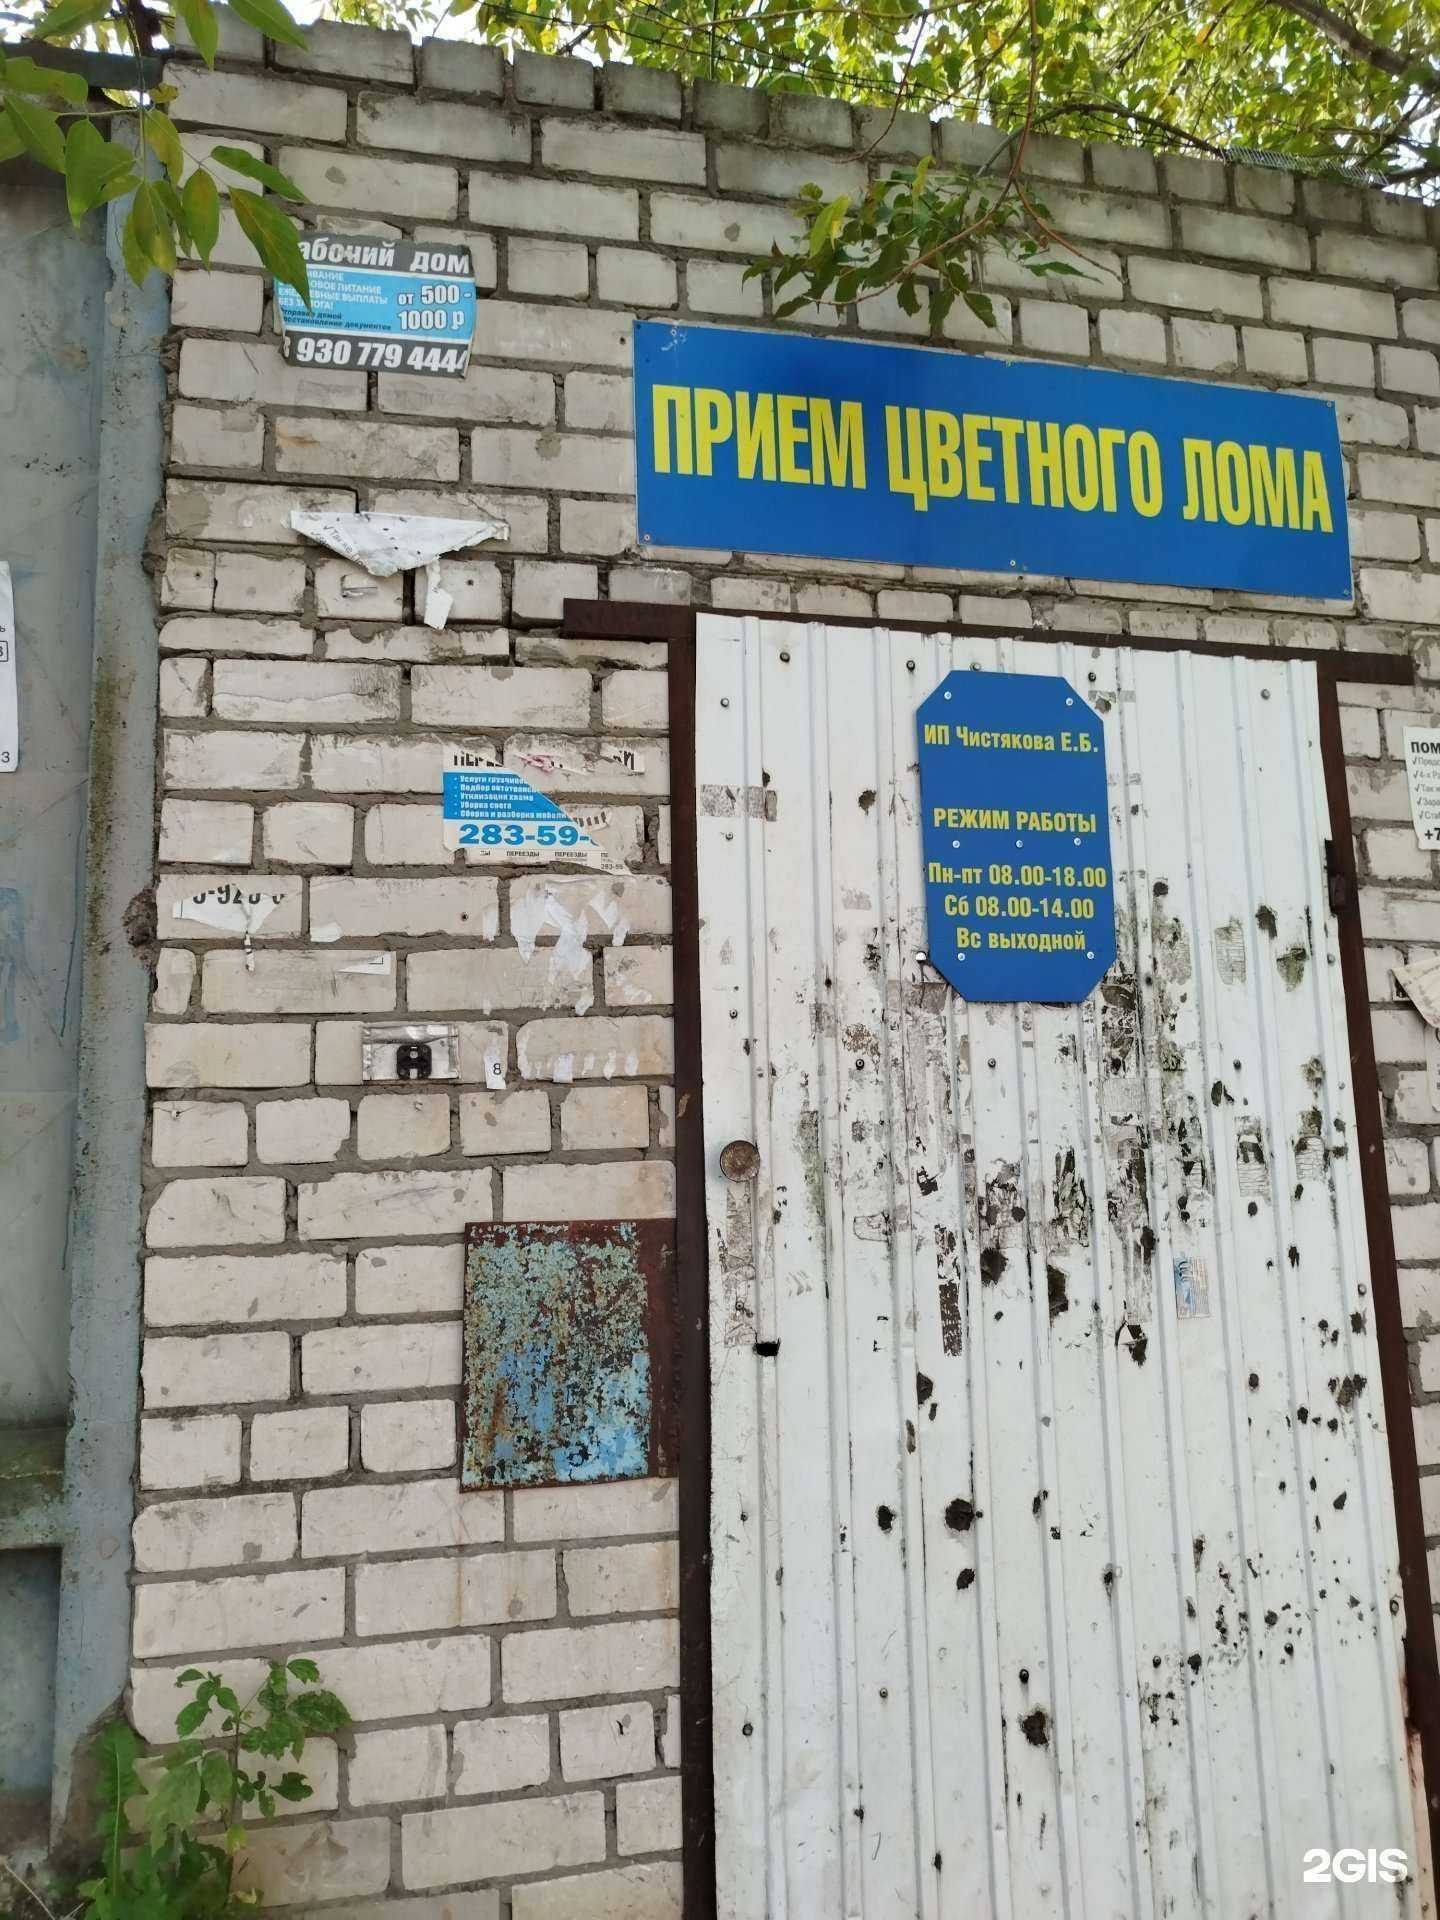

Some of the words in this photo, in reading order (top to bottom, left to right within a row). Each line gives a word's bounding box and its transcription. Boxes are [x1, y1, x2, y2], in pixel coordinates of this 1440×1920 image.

[298, 237, 395, 267] абочий
[398, 292, 414, 305] от
[421, 284, 460, 305] 500
[398, 310, 447, 331] 1000
[296, 338, 351, 365] 930
[357, 342, 403, 368] 779
[651, 383, 867, 489] ПРИЕМ
[884, 405, 1164, 518] ЦВЕТНОГО
[1183, 437, 1334, 533] ЛОМА
[924, 724, 950, 745] ИП
[956, 726, 1056, 751] Чистякова
[1061, 732, 1099, 753] Е.Б.
[934, 807, 1010, 831] РЕЖИМ
[1016, 811, 1097, 833] РАБОТЫ
[459, 823, 600, 847] 283-59-
[928, 862, 983, 885] Пн-пт
[989, 864, 1107, 888] 08.00-18.00
[945, 894, 969, 917] Сб
[975, 895, 1095, 919] 08.00-14.00
[956, 927, 982, 949] Вс
[988, 930, 1086, 953] выходной
